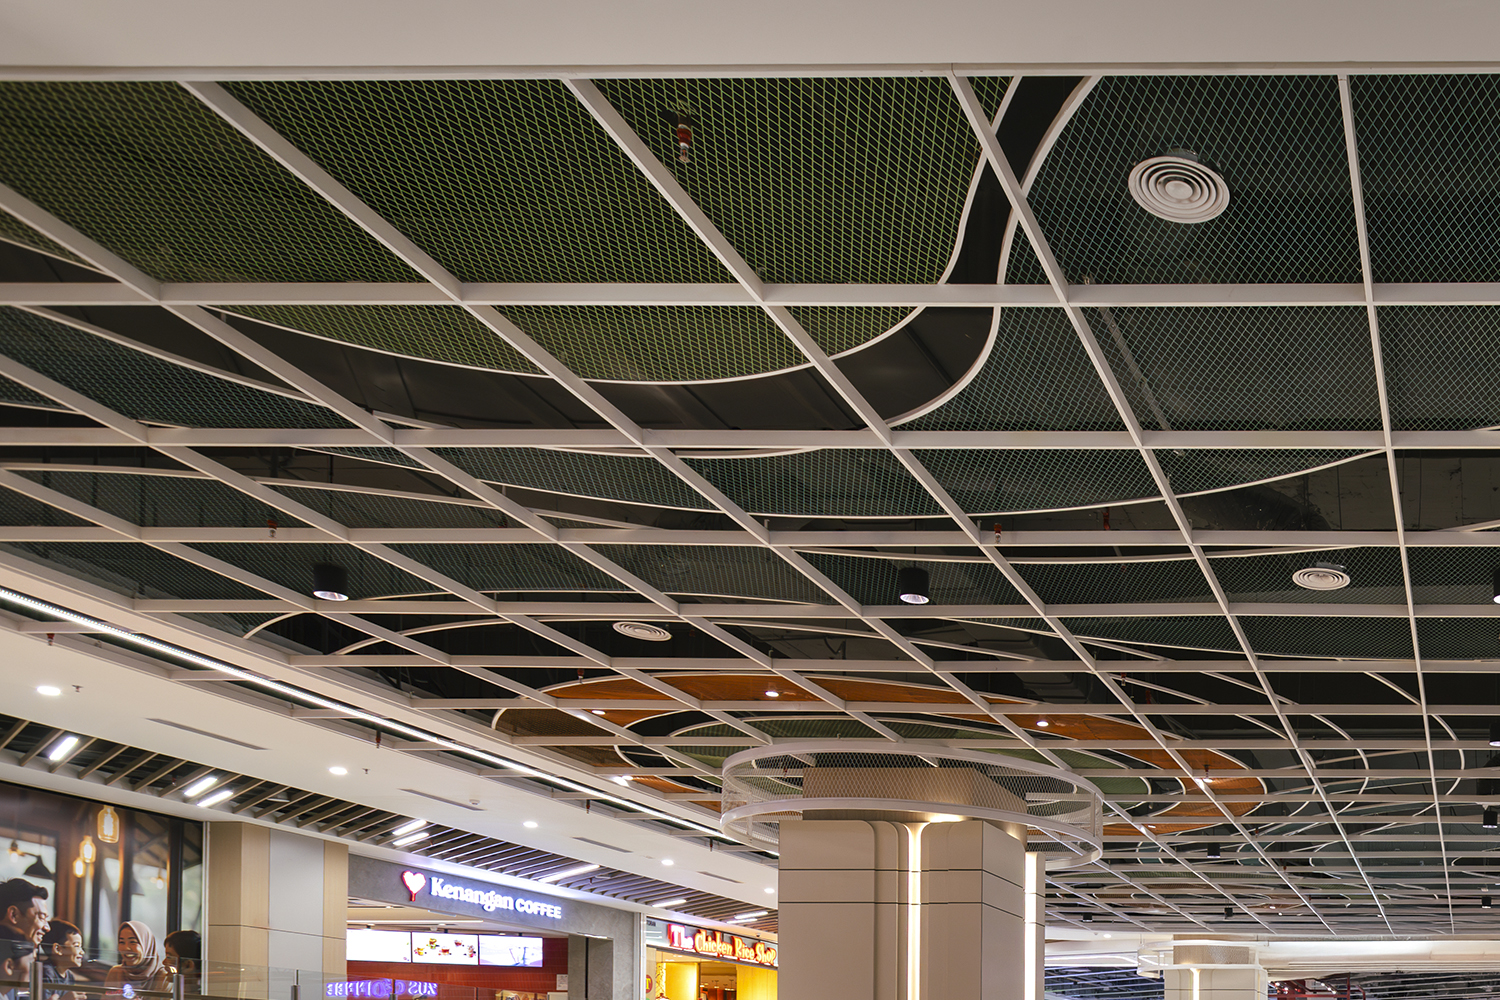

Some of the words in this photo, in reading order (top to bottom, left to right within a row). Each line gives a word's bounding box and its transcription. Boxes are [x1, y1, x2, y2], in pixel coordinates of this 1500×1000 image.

[430, 876, 514, 912] Kenangan
[514, 898, 562, 919] COFFEE
[668, 923, 694, 950] The
[694, 928, 733, 957] Chicken
[731, 935, 755, 960] Rice
